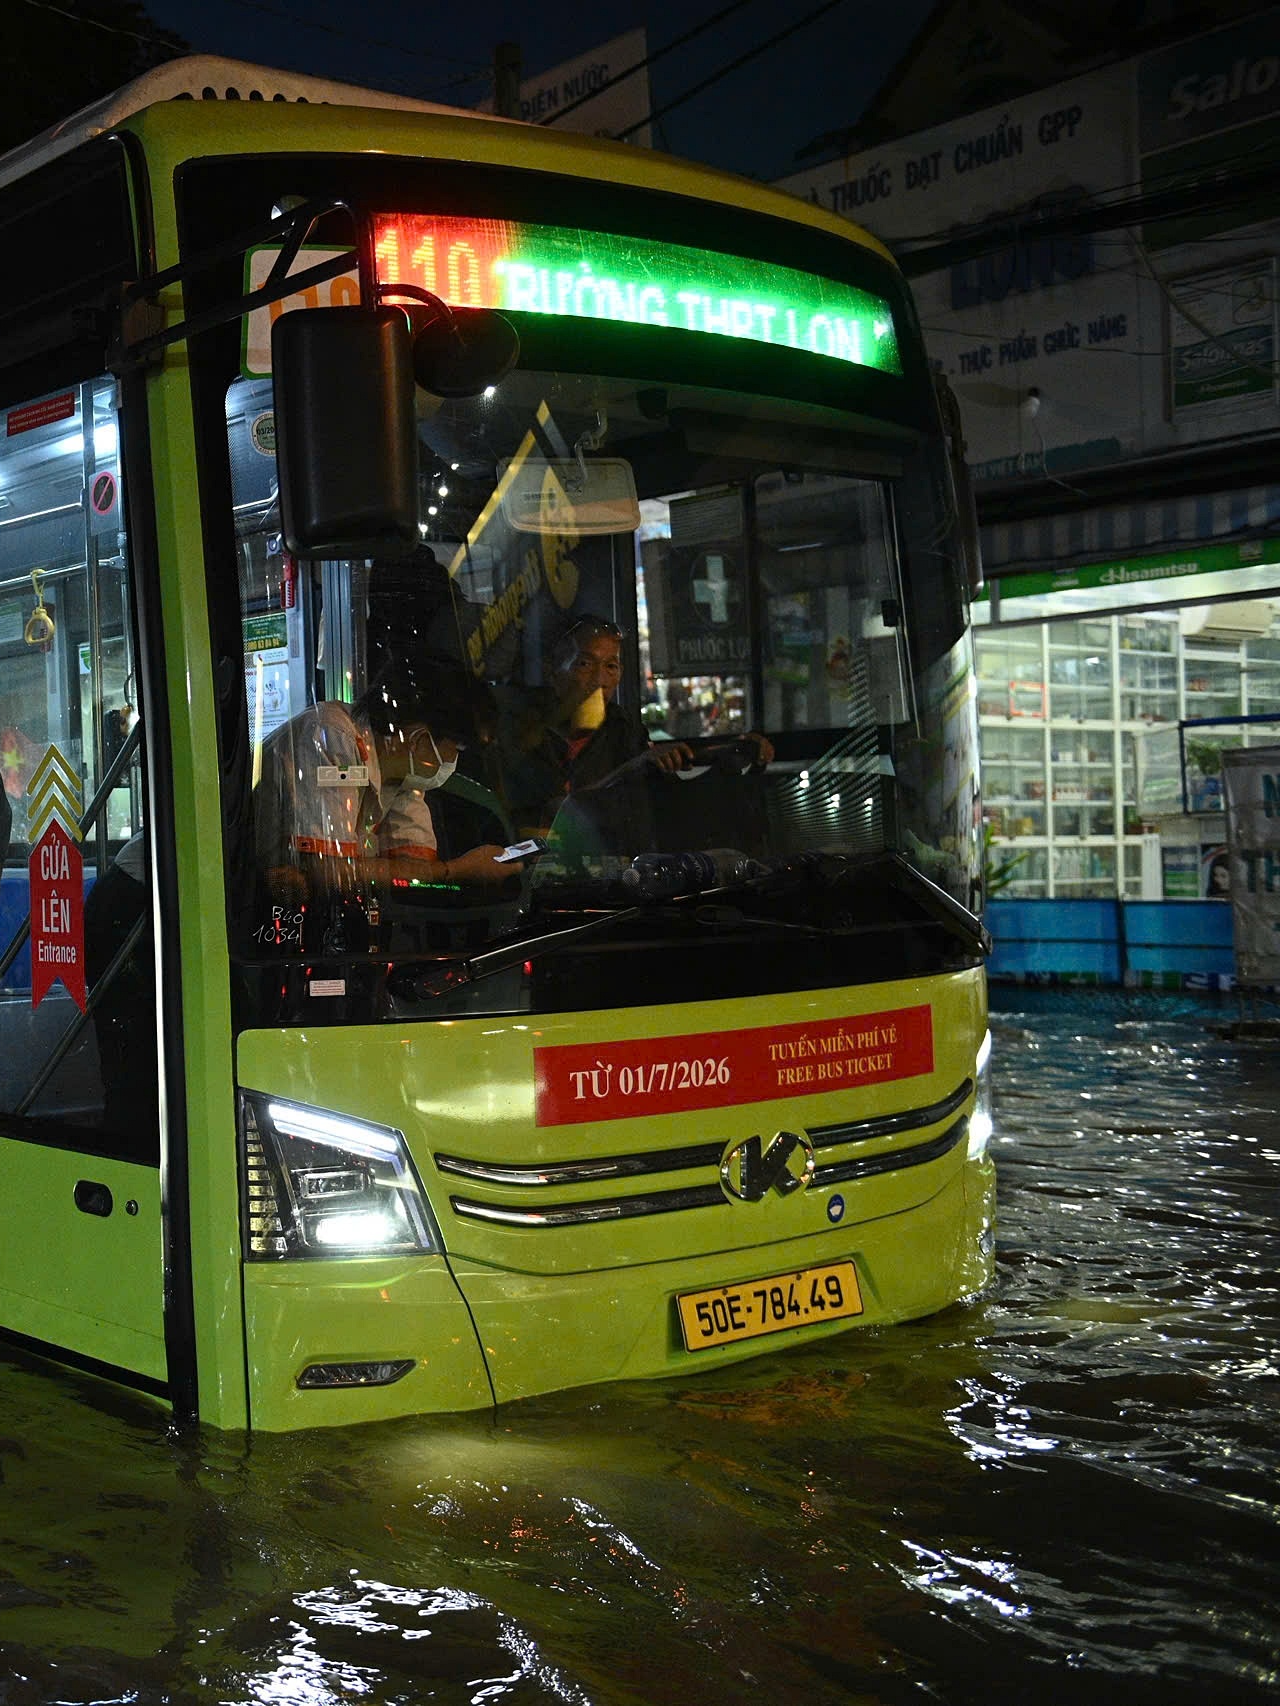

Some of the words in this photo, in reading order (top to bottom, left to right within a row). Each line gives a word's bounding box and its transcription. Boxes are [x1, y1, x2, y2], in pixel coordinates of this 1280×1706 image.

[905, 153, 942, 191] ĐẠT
[954, 113, 1024, 174] CHUẨN
[1037, 104, 1083, 146] GPP
[375, 229, 481, 306] 110
[494, 260, 668, 327] RƯỜNG
[677, 291, 776, 343] THPT
[40, 834, 70, 881] CỬA
[41, 889, 71, 934] LÊN
[272, 906, 304, 924] B40
[38, 941, 77, 966] Entrance
[768, 1034, 817, 1061] TUYẾN
[819, 1028, 857, 1055] MIỄN
[858, 1025, 880, 1050] PHÍ
[881, 1022, 898, 1046] VÉ
[569, 1060, 612, 1100] TỪ
[618, 1056, 730, 1095] 01/7/2026
[777, 1067, 815, 1087] FREE
[817, 1062, 844, 1082] BUS
[846, 1052, 895, 1079] TICKET
[695, 1275, 844, 1338] 50E-784.49
